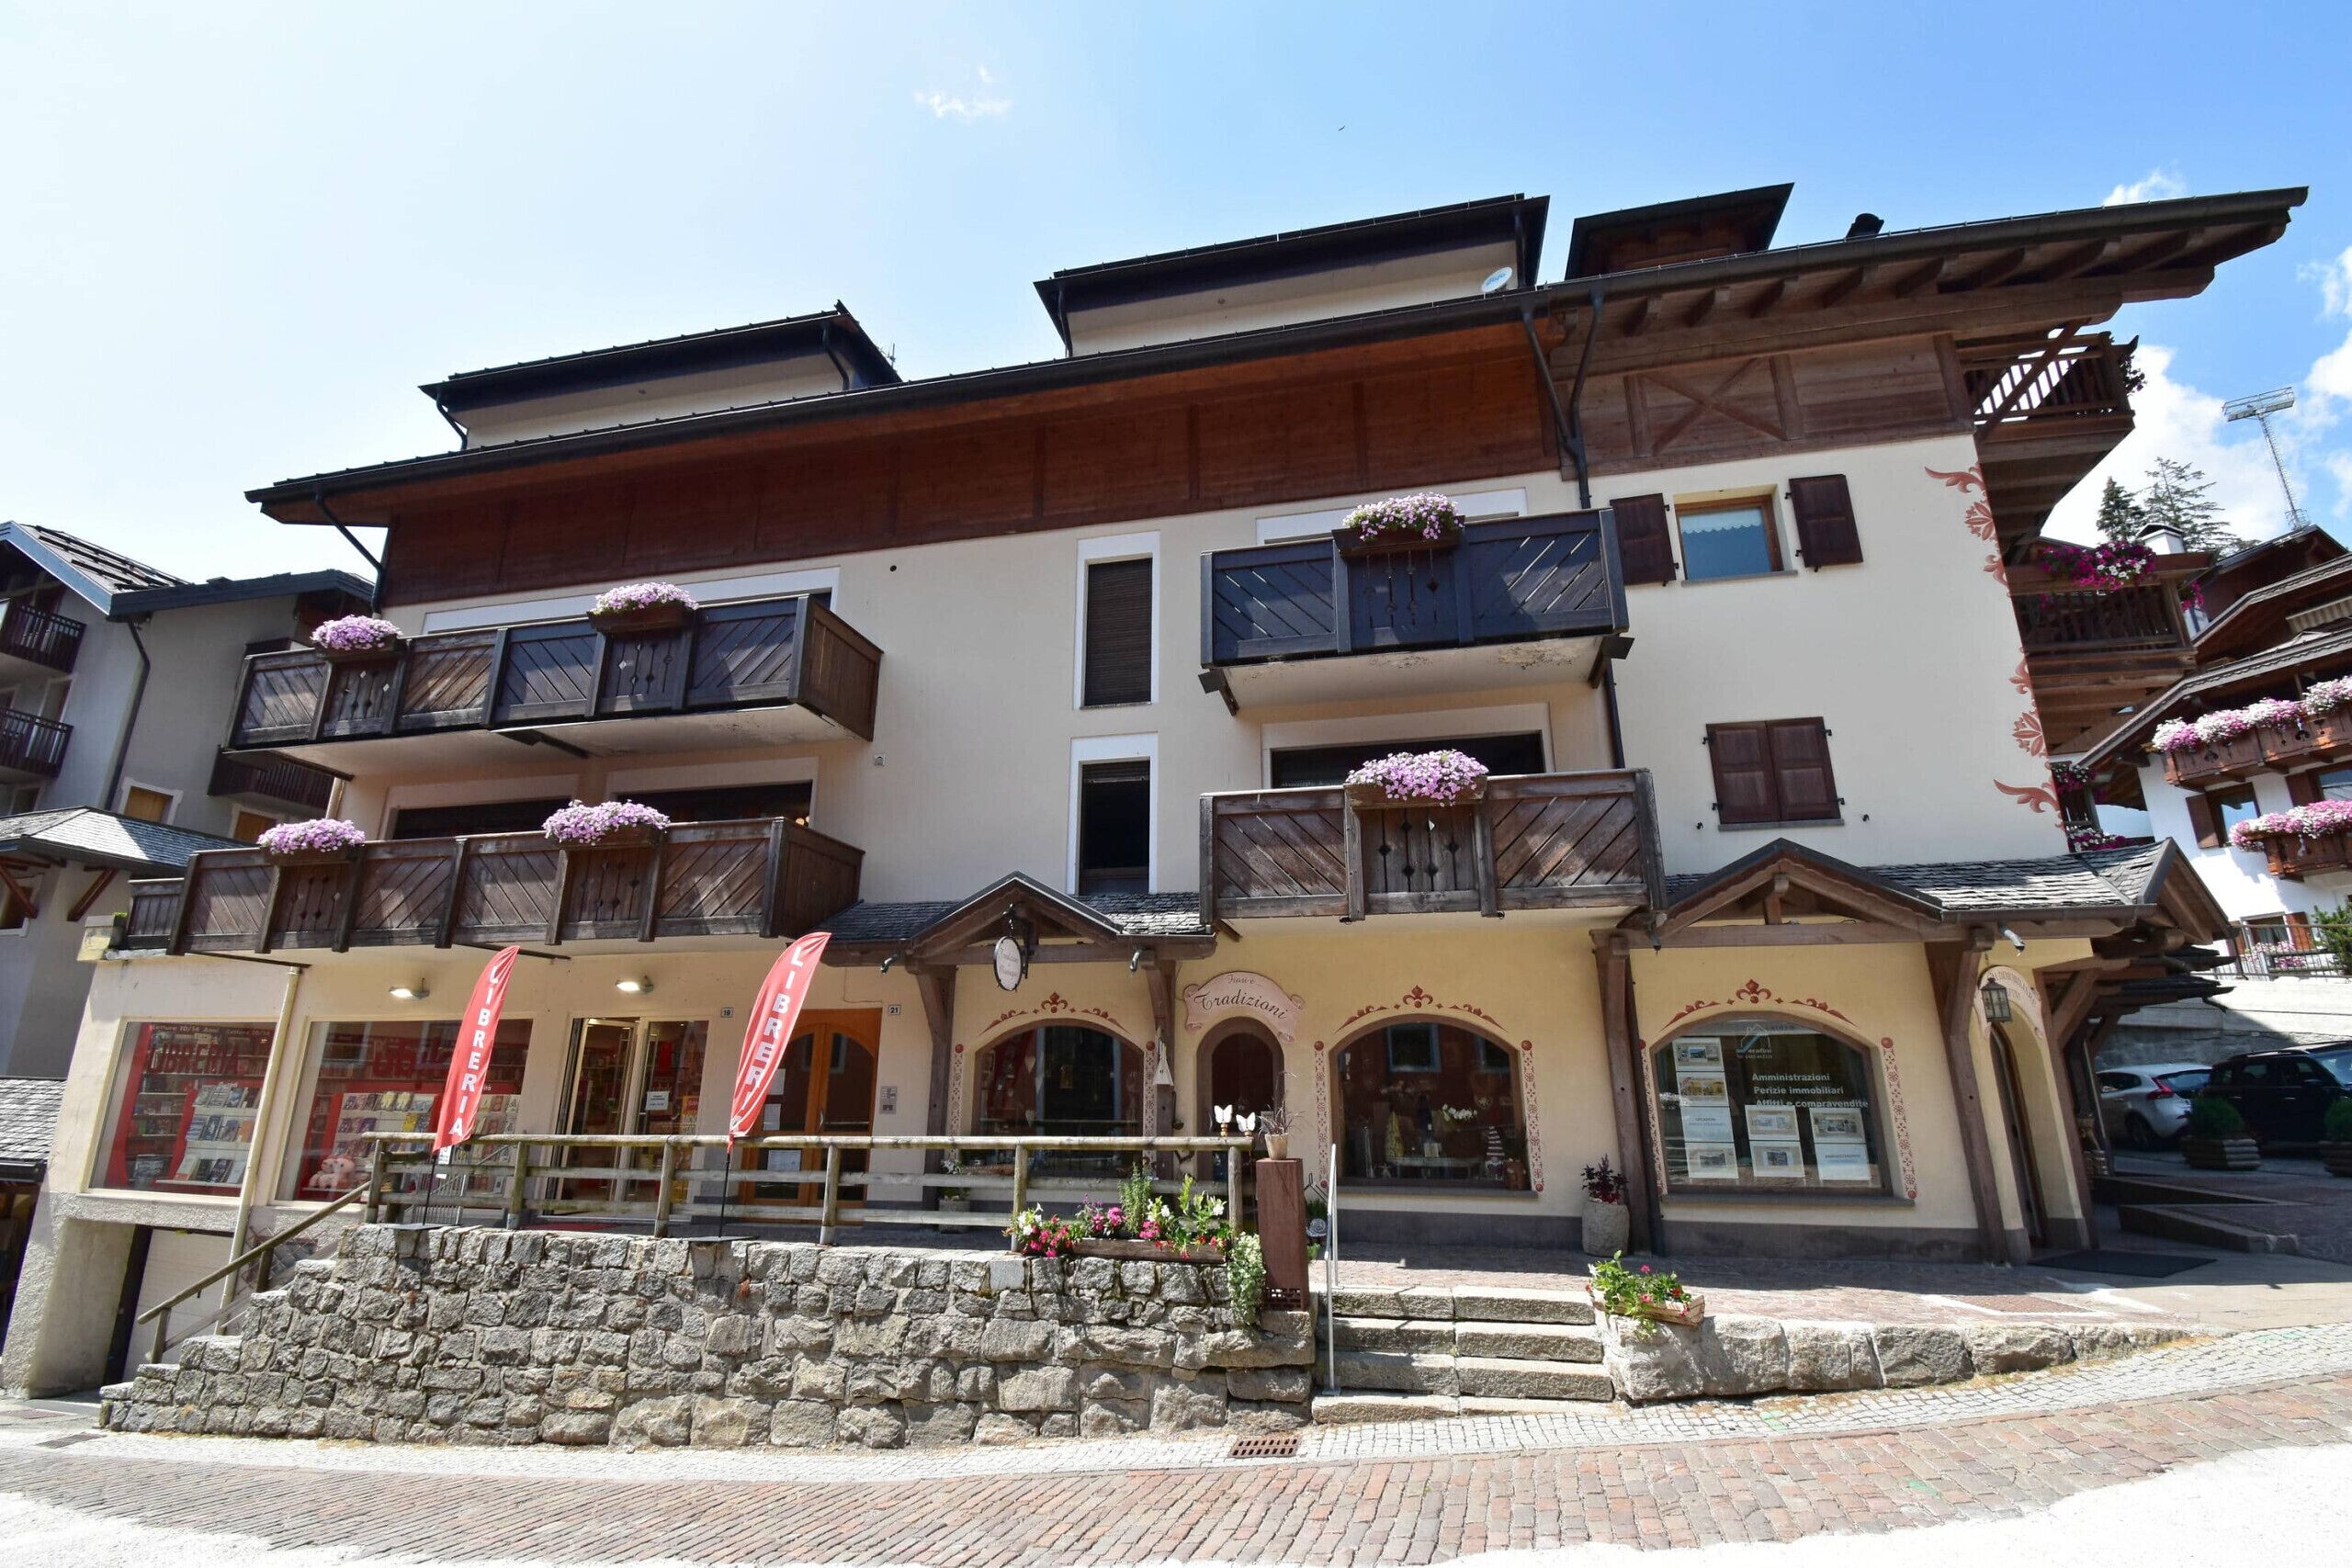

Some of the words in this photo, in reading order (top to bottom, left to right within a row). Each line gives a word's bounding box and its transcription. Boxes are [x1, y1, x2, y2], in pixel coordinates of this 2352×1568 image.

[1194, 989, 1288, 1019] Tradizioni
[723, 1009, 731, 1017] 19
[448, 965, 499, 1137] LIBRERIA
[1751, 1073, 1830, 1081] Amministrazioni
[1789, 1086, 1844, 1094] immobiliari
